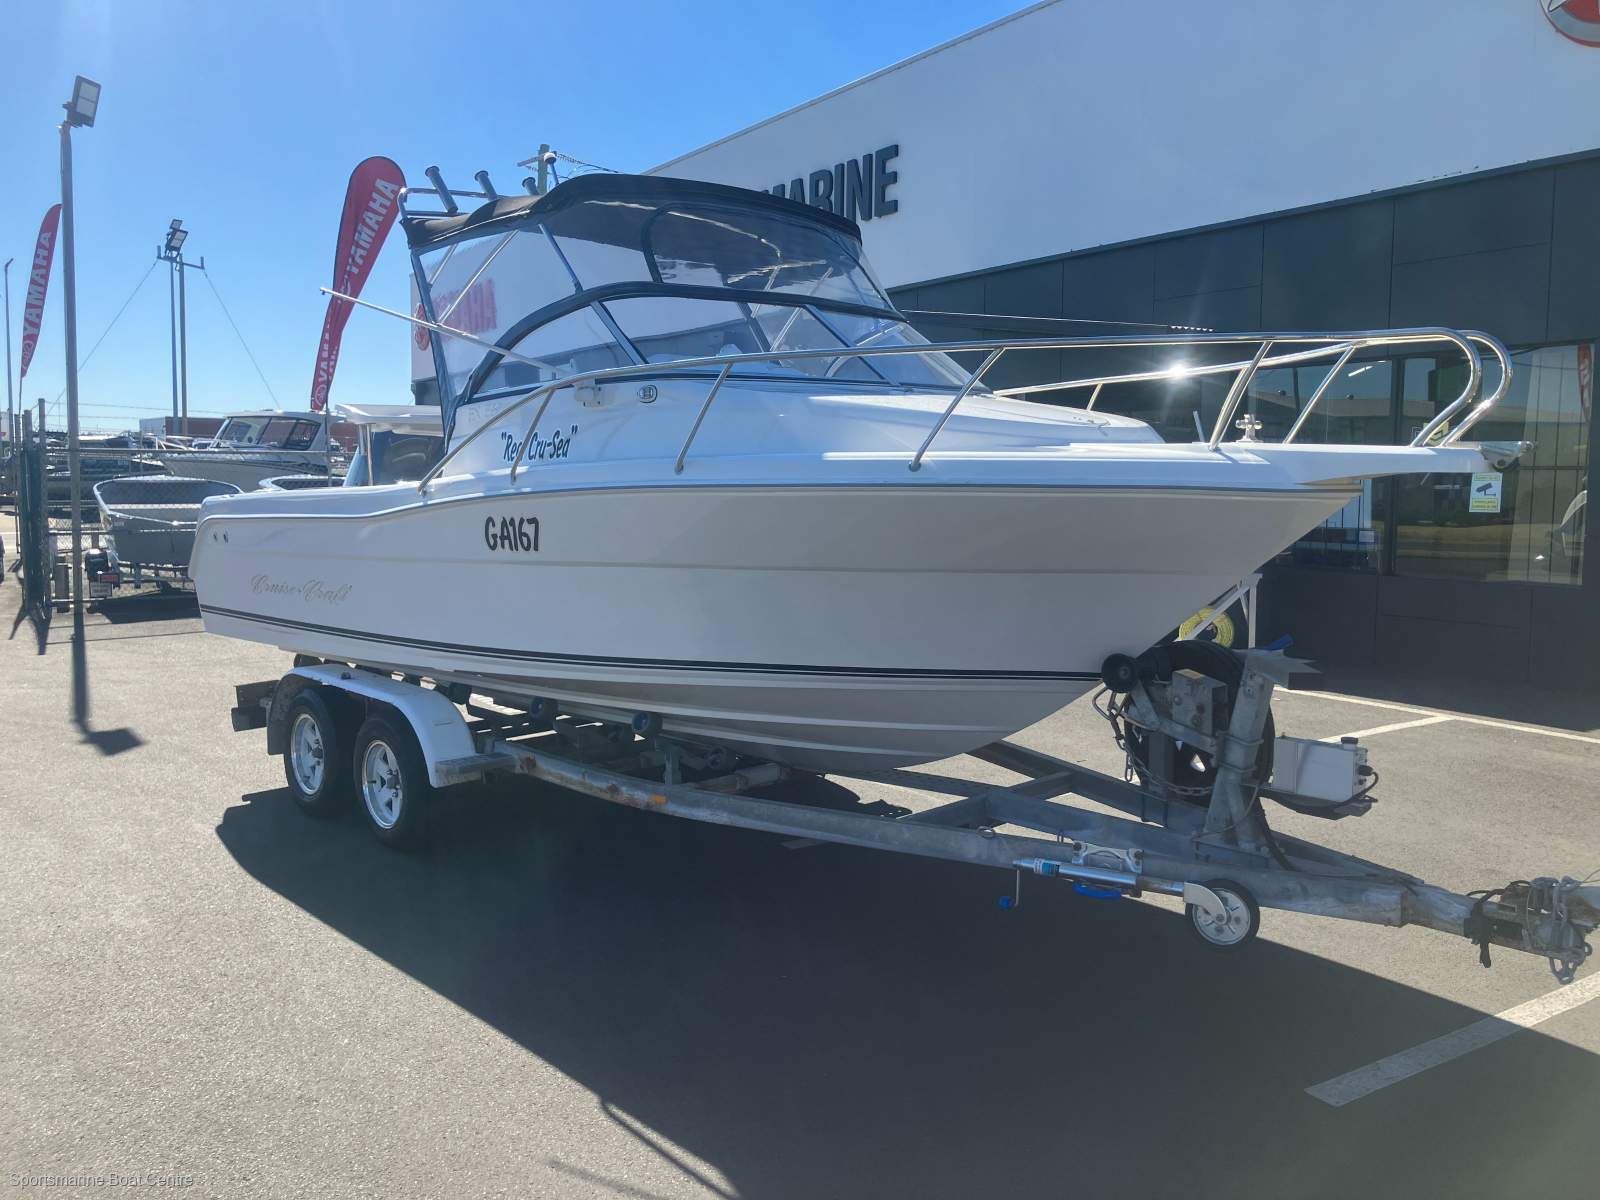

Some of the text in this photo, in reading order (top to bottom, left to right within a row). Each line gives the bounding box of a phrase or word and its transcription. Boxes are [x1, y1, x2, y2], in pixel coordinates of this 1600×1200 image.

[760, 144, 899, 221] RINE
[23, 231, 52, 336] YAMAHA
[484, 516, 540, 551] GA167
